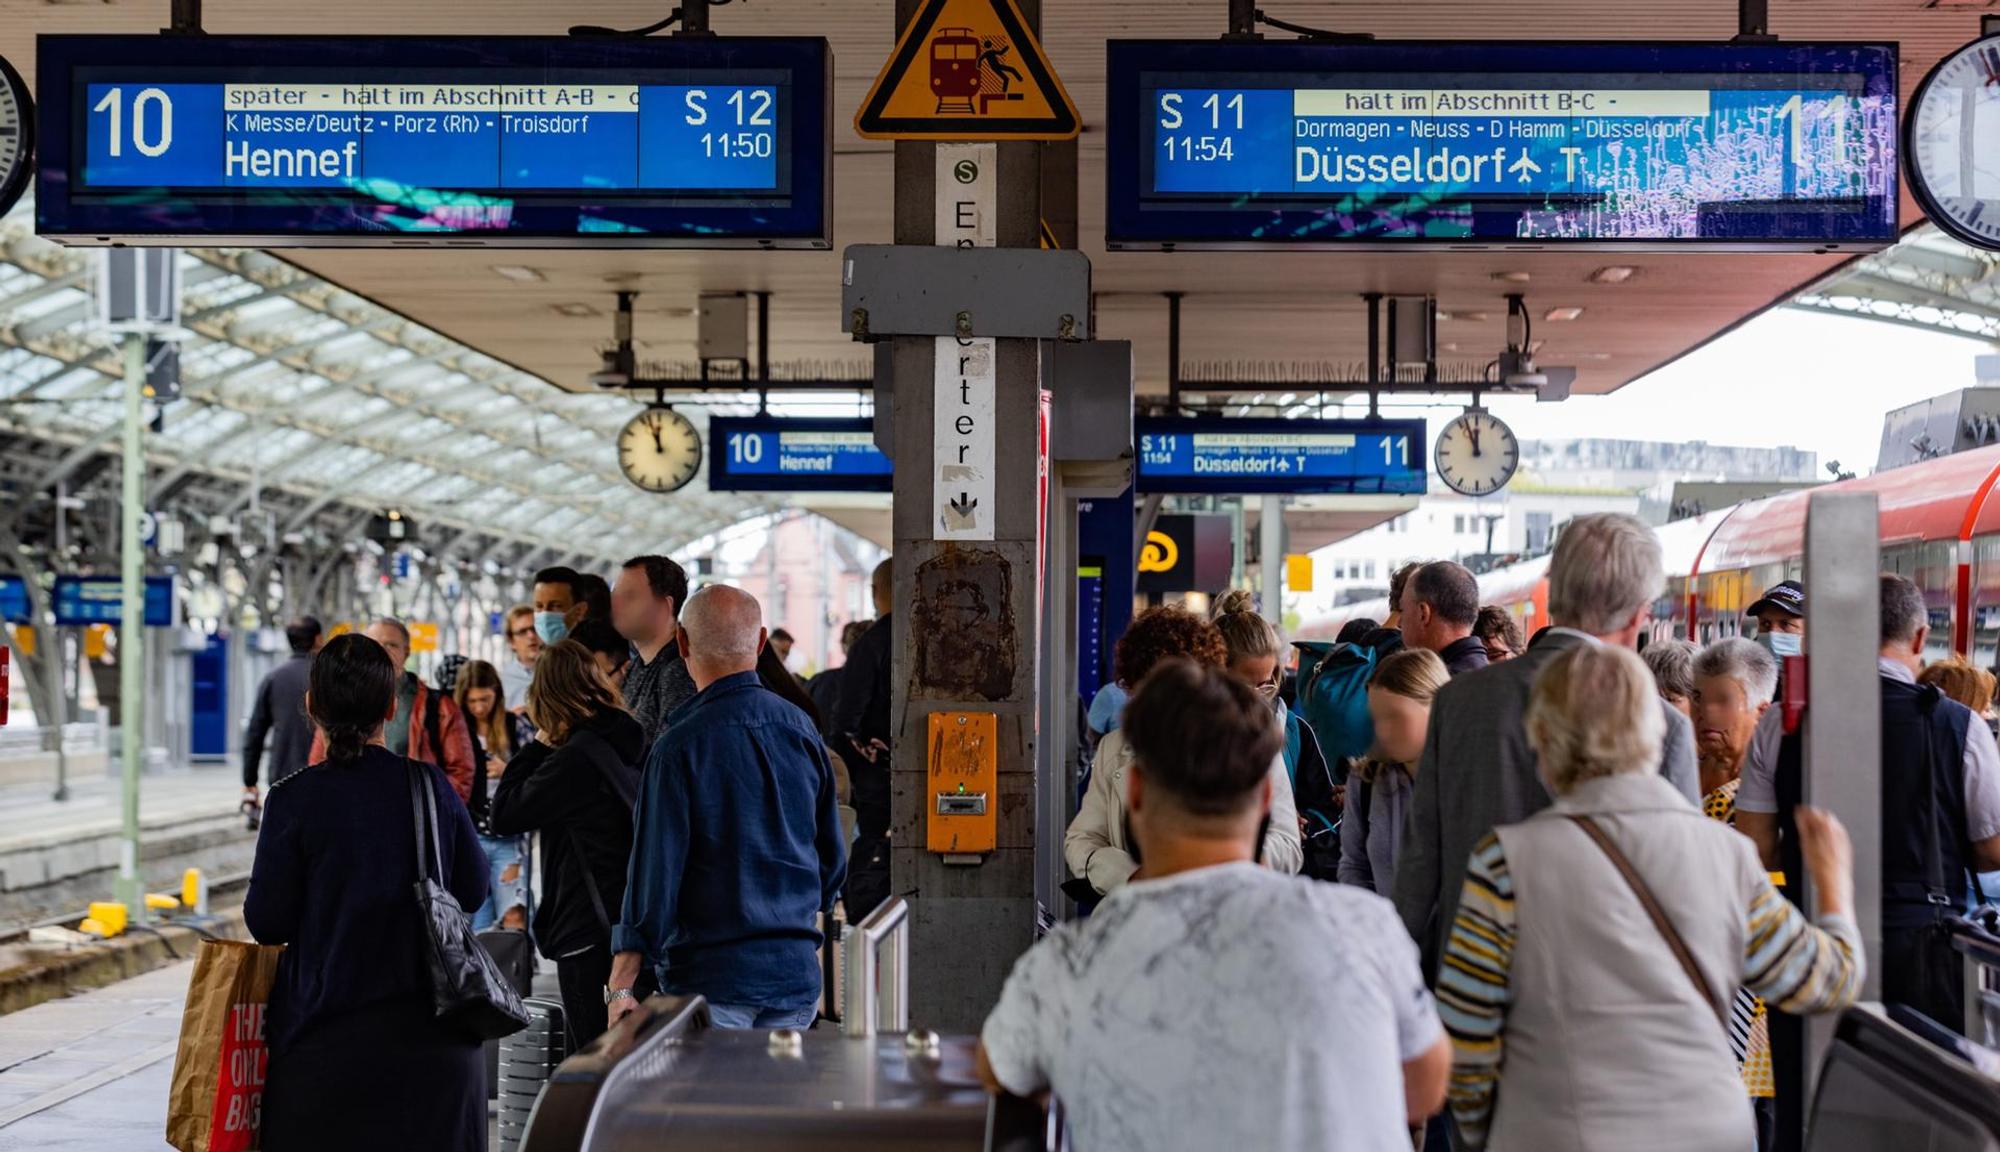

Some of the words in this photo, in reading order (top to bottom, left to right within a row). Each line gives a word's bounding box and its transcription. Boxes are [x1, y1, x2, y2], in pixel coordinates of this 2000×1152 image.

[231, 88, 306, 109] später
[343, 87, 392, 105] hält
[400, 88, 422, 105] im
[434, 88, 547, 105] Abschnitt
[555, 88, 593, 105] A-B
[685, 90, 707, 125] S
[727, 90, 772, 125] 12
[1161, 93, 1183, 129] S
[1202, 93, 1244, 129] 11
[1345, 93, 1394, 110] hält
[1401, 93, 1427, 110] im
[1436, 93, 1550, 110] Abschnitt
[1558, 93, 1595, 110] B-C
[94, 88, 173, 157] 10
[226, 114, 239, 132] K
[245, 114, 374, 133] Messe/Deutz
[394, 115, 437, 133] Porz
[443, 114, 480, 134] (Rh)
[502, 115, 589, 133] Troisdorf
[1296, 120, 1390, 142] Dormagen
[1410, 120, 1470, 138] Neuss
[1490, 120, 1503, 138] D
[1509, 120, 1565, 138] Hamm
[1586, 119, 1691, 139] Düsseldorf
[1774, 94, 1847, 164] 11
[226, 141, 357, 177] Hennef
[701, 133, 772, 157] 11:50
[1163, 137, 1234, 161] 11:54
[1296, 146, 1506, 183] Düsseldorf
[1559, 147, 1582, 183] T
[729, 433, 763, 464] 10
[1141, 435, 1153, 452] S
[1158, 435, 1176, 452] 11
[1379, 436, 1409, 466] 11
[779, 454, 833, 471] Hennef
[1193, 455, 1277, 473] Düsseldorf
[1296, 456, 1306, 473] T
[233, 1003, 267, 1041] THE
[231, 1048, 269, 1087] ONL
[224, 1092, 262, 1132] BAG
